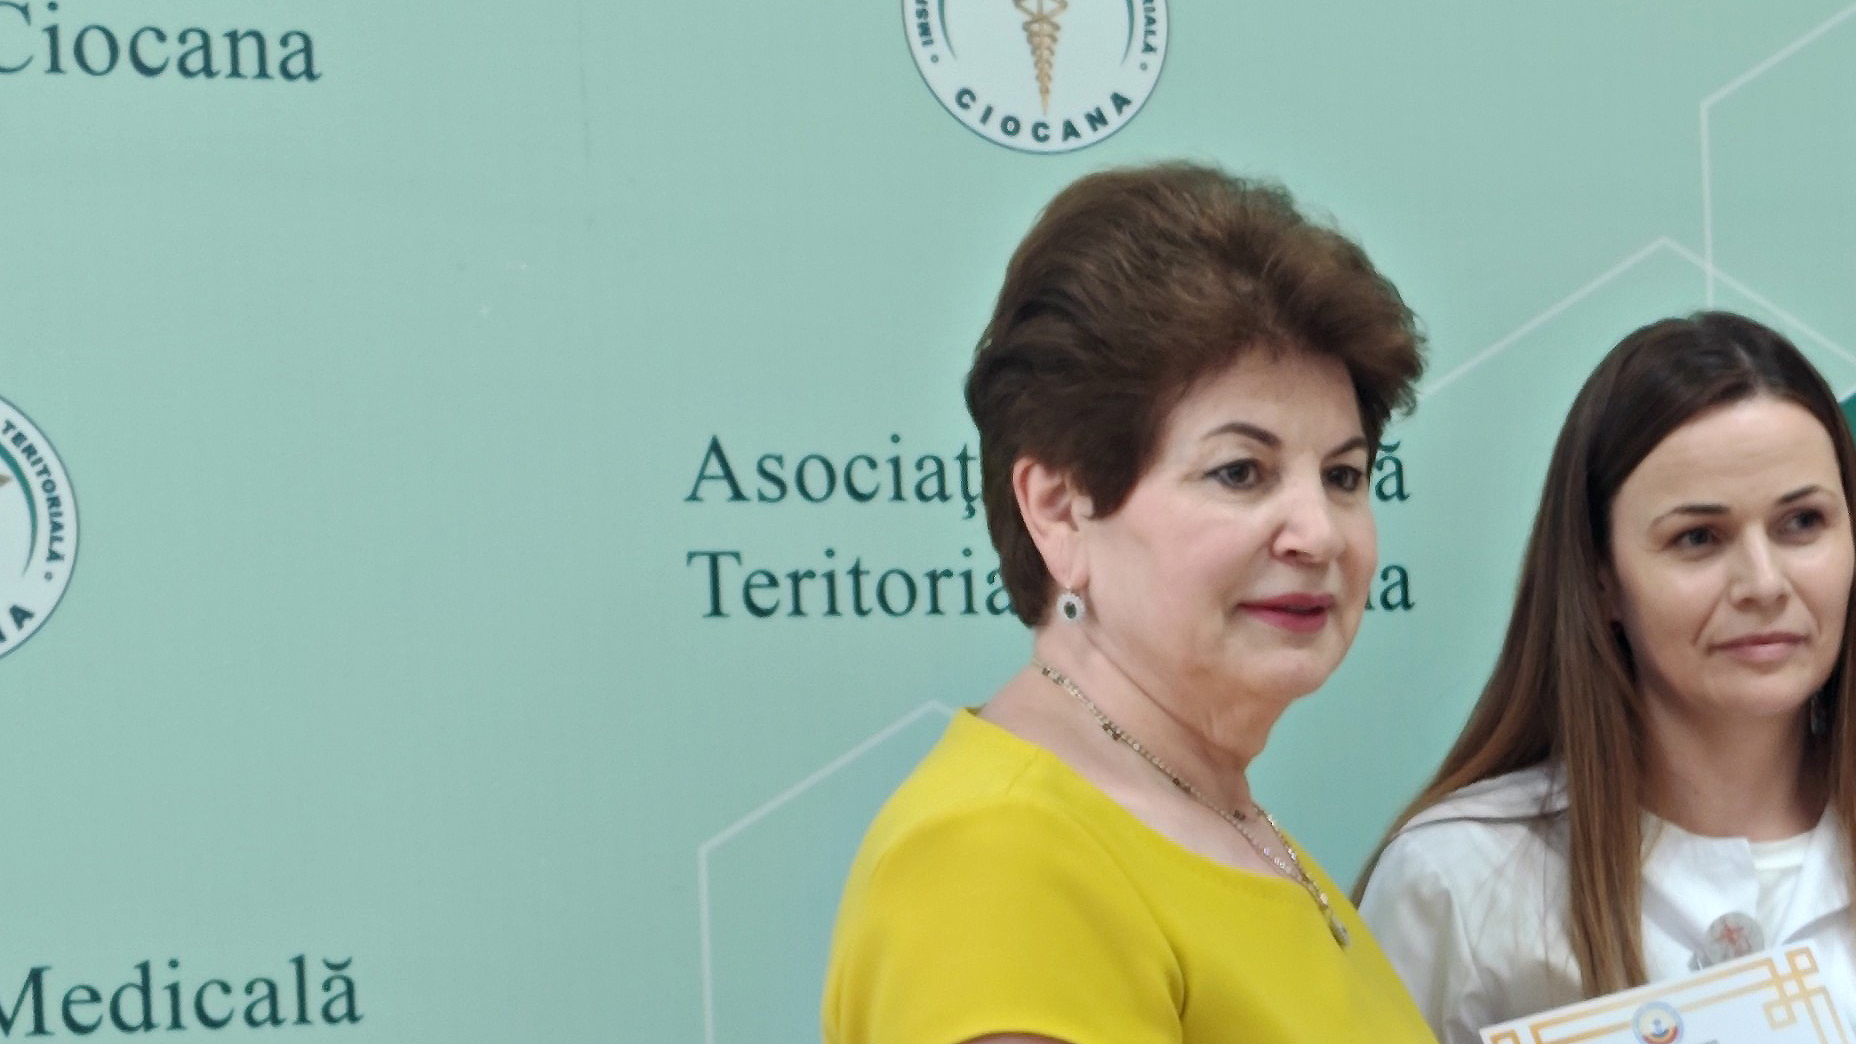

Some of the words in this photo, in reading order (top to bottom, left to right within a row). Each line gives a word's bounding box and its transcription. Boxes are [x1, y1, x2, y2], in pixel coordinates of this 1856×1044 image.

[0, 0, 323, 82] Ciocana
[955, 87, 1132, 143] CIOCANA
[686, 547, 1018, 619] Teritoria
[0, 953, 364, 1038] Medicală
